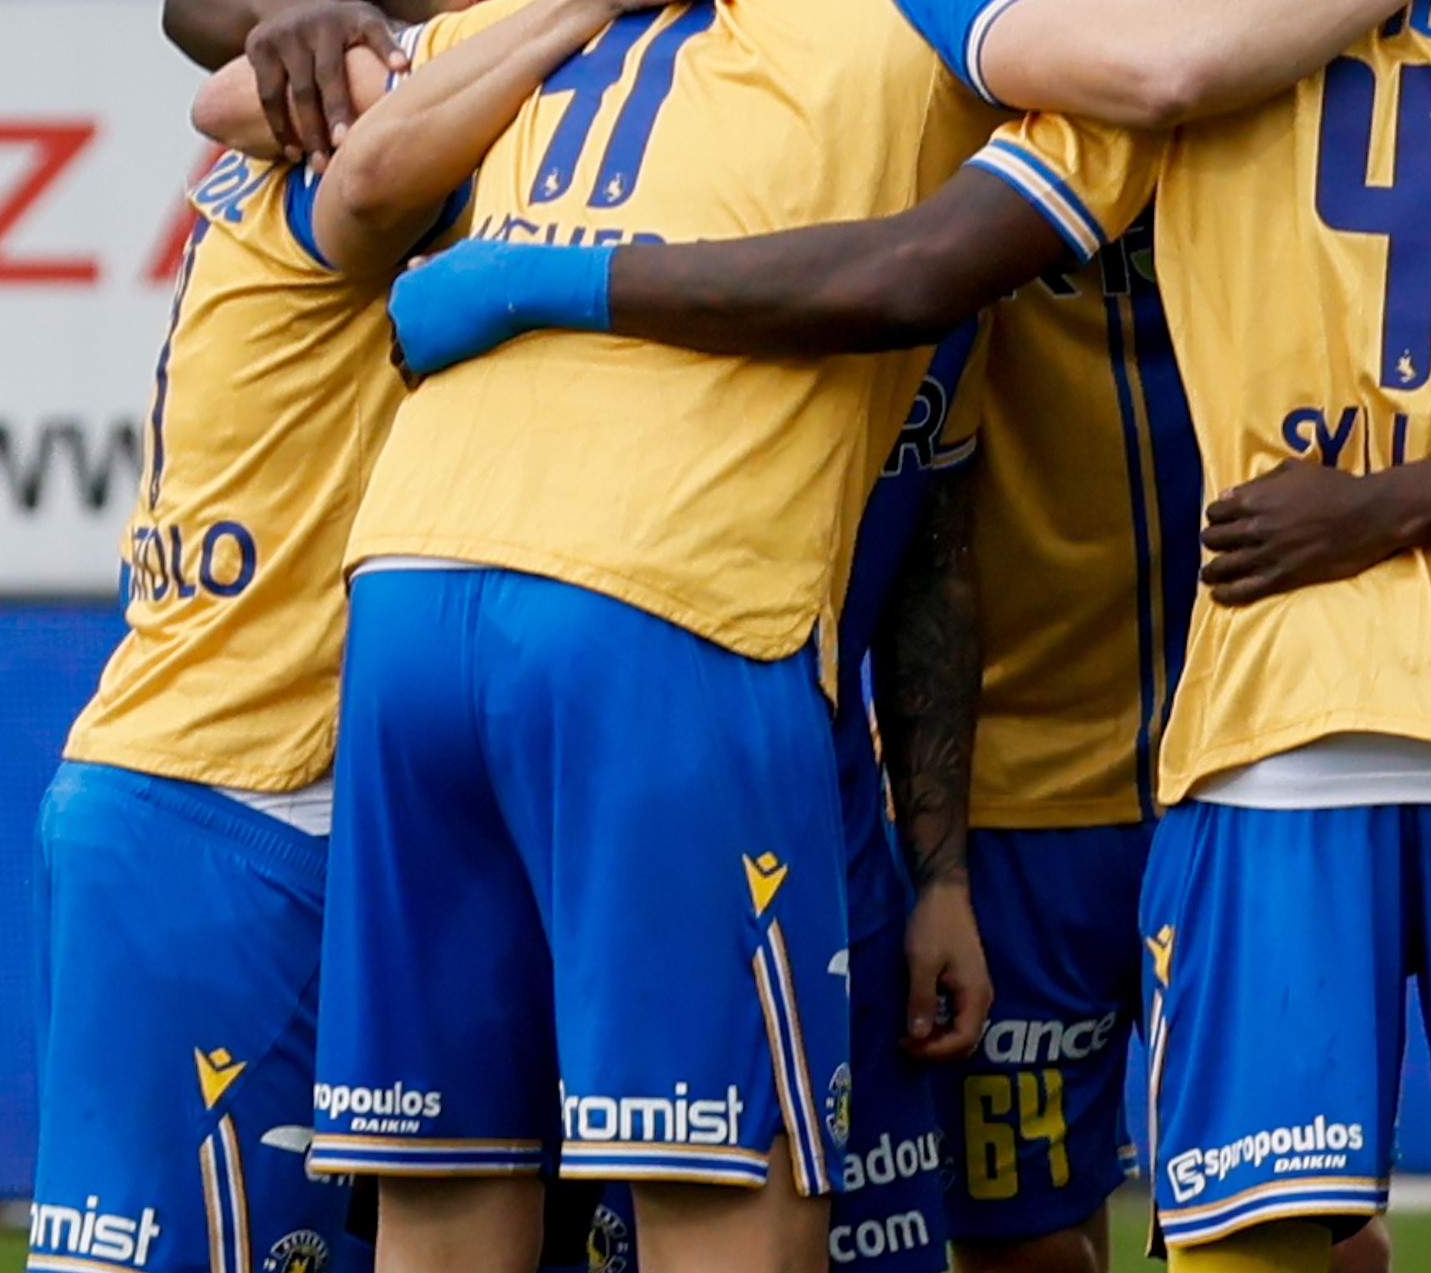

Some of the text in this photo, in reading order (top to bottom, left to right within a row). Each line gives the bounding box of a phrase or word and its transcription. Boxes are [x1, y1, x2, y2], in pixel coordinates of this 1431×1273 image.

[350, 1117, 421, 1133] DAIKIN
[558, 1081, 744, 1146] romist
[964, 1068, 1070, 1200] 64
[1273, 1153, 1348, 1174] DAIKIN
[28, 1194, 160, 1266] mist
